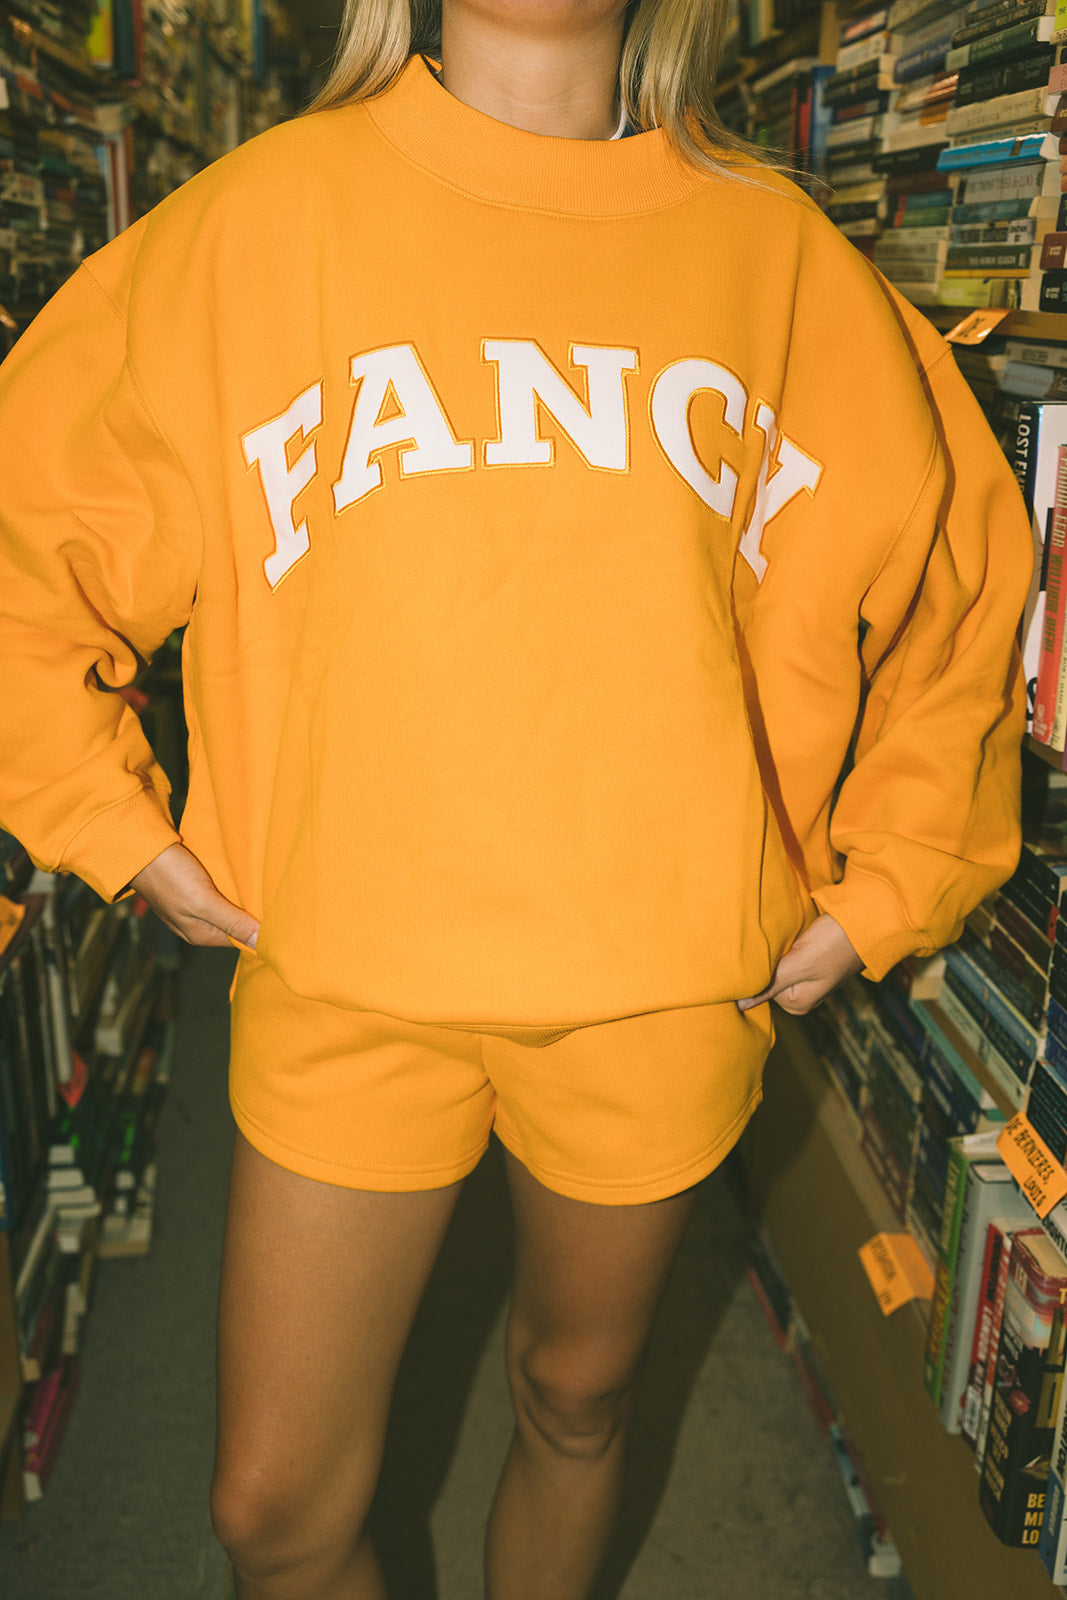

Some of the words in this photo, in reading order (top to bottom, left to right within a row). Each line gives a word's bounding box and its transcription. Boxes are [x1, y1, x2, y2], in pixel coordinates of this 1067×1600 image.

[1016, 414, 1032, 458] LOST
[240, 337, 824, 592] FANCY
[1052, 514, 1067, 548] FEAR
[1045, 553, 1064, 613] WILLIAM
[1042, 615, 1057, 653] DIEHL
[1006, 1117, 1023, 1136] DE
[1021, 1529, 1040, 1544] LO
